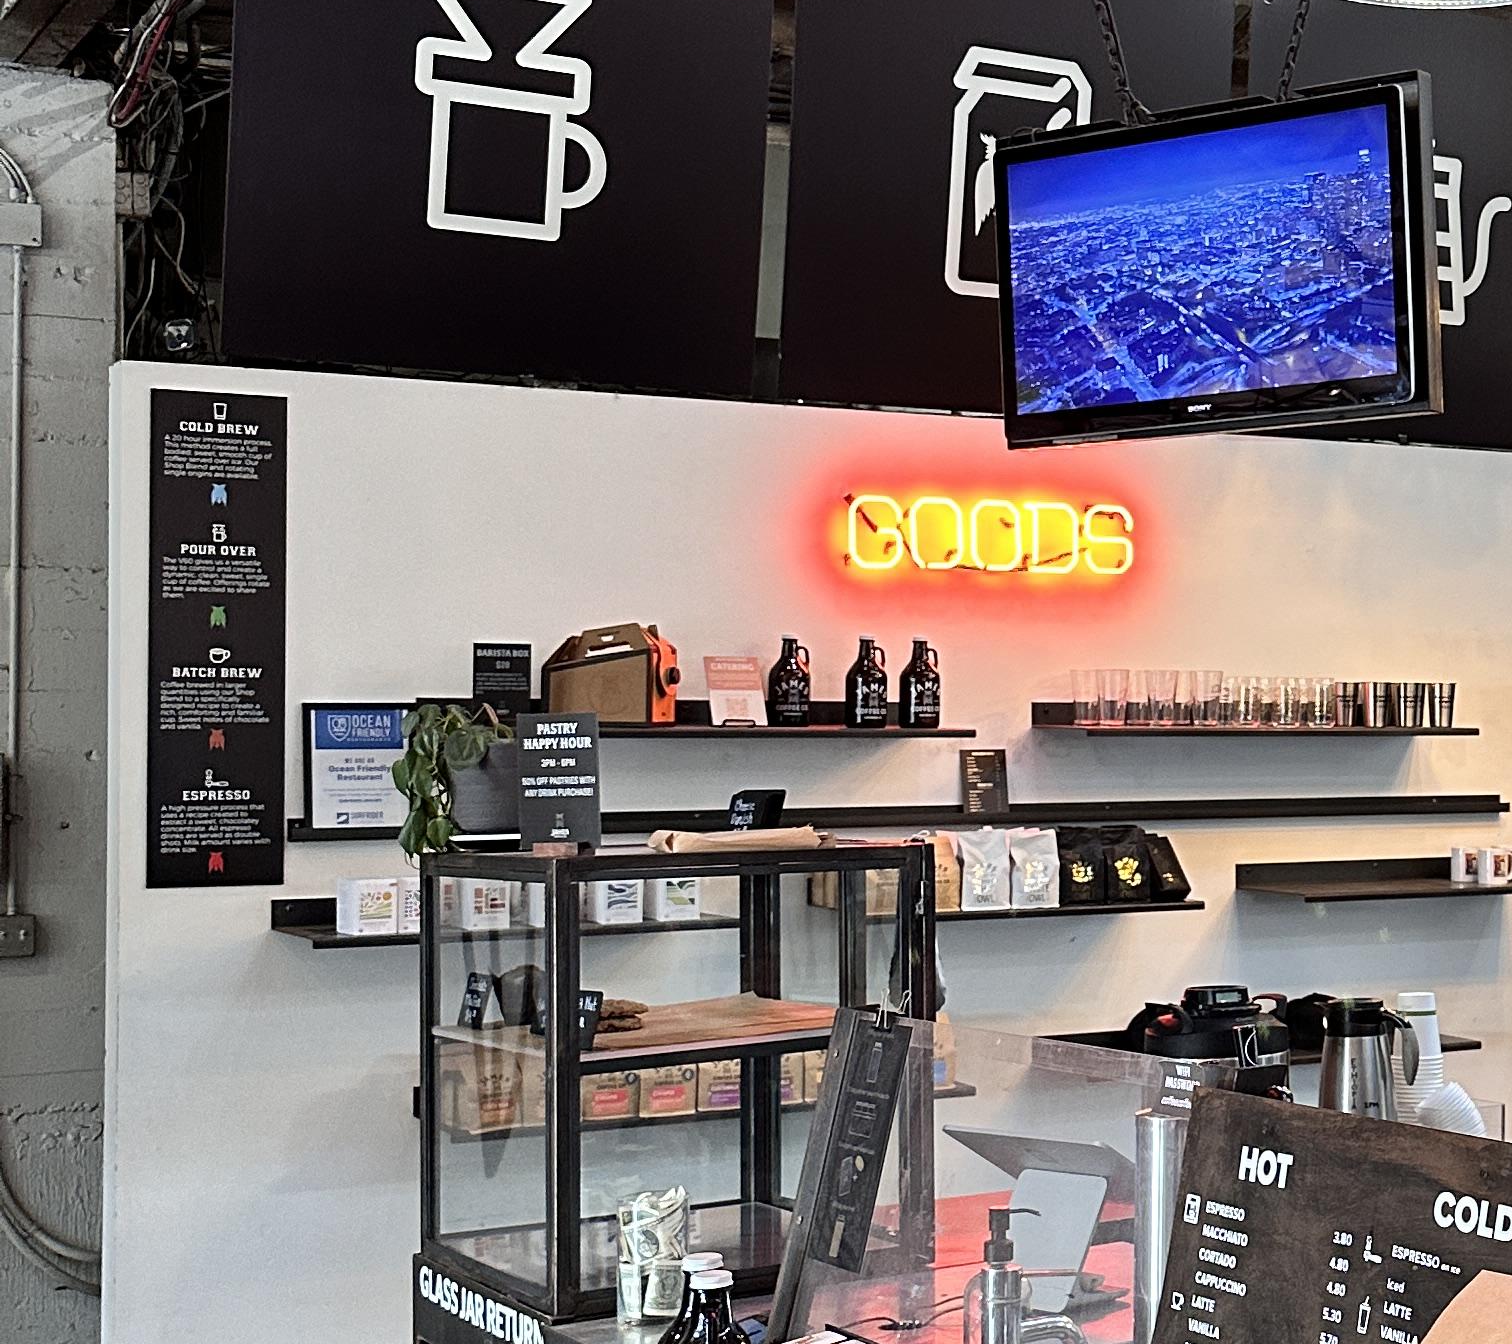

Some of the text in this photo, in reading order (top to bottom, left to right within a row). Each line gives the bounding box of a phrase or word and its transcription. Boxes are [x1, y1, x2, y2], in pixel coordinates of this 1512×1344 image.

[179, 421, 259, 436] COLD BREW
[846, 493, 1136, 575] GOODS
[180, 544, 257, 557] POUR OVER
[172, 667, 263, 679] BATCH BREW
[352, 715, 391, 728] OCEAN
[352, 728, 391, 737] FRIENDLY
[537, 722, 579, 735] PASTRY
[523, 737, 593, 750] HAPPY HOUR
[182, 790, 251, 801] ESPRESSO
[1238, 1145, 1294, 1189] HOT
[1205, 1200, 1246, 1222] ESPRESSO
[1202, 1224, 1353, 1247] MACCHIATO 3.80
[1199, 1248, 1350, 1273] CORTADO 4.80
[1391, 1244, 1440, 1269] ESPRESSO
[1195, 1271, 1346, 1297] CAPPUCCINO 4.80
[420, 1265, 459, 1315] GLASS
[459, 1287, 485, 1330] JAR
[1191, 1295, 1342, 1323] LATTE 5.30
[1383, 1300, 1413, 1321] LATTE
[1188, 1317, 1220, 1340] VANILLA
